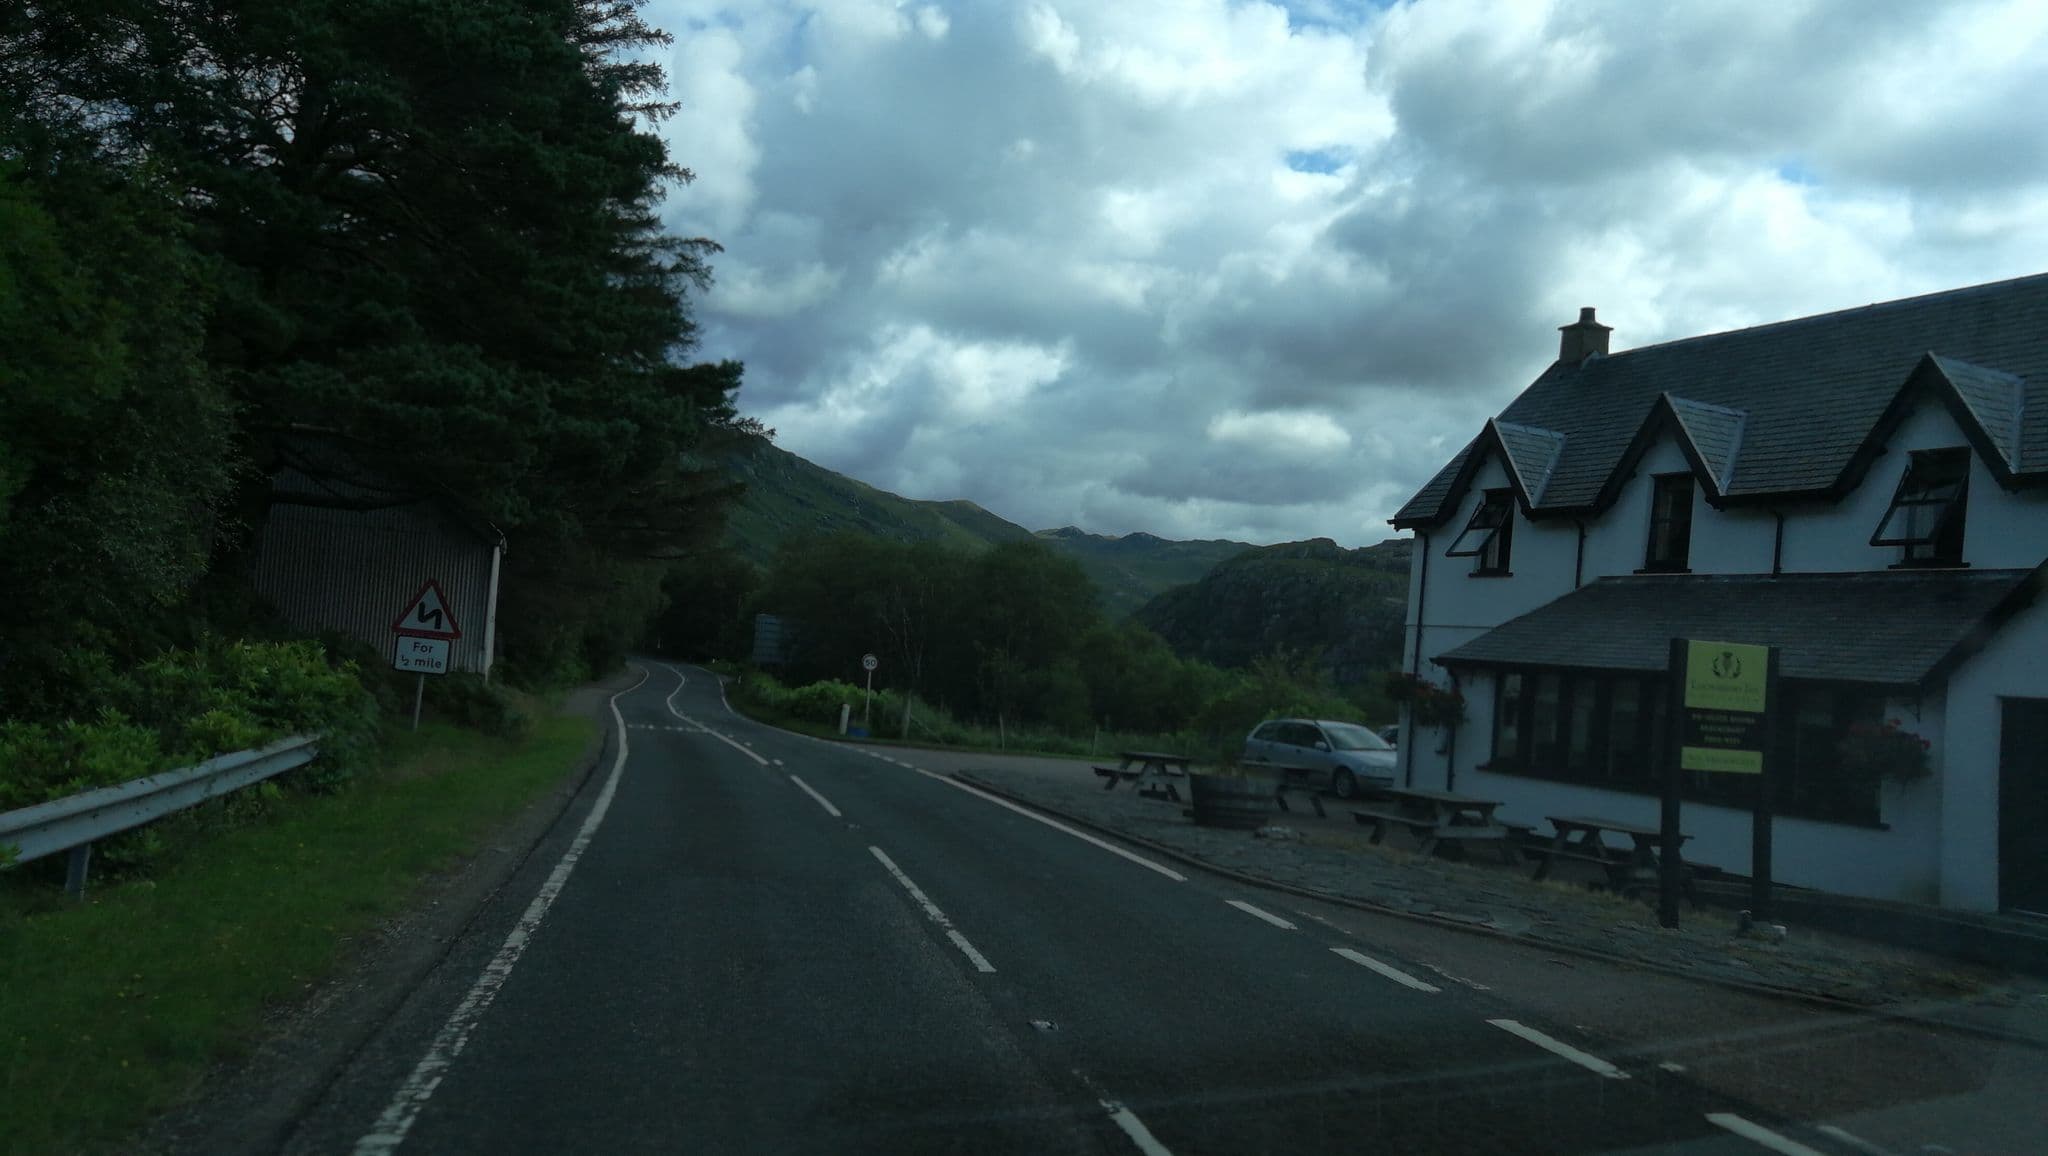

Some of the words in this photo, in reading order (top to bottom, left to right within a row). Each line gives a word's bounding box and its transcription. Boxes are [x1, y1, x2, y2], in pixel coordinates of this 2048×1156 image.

[413, 642, 434, 653] For
[414, 658, 442, 668] mile
[865, 659, 876, 667] 50
